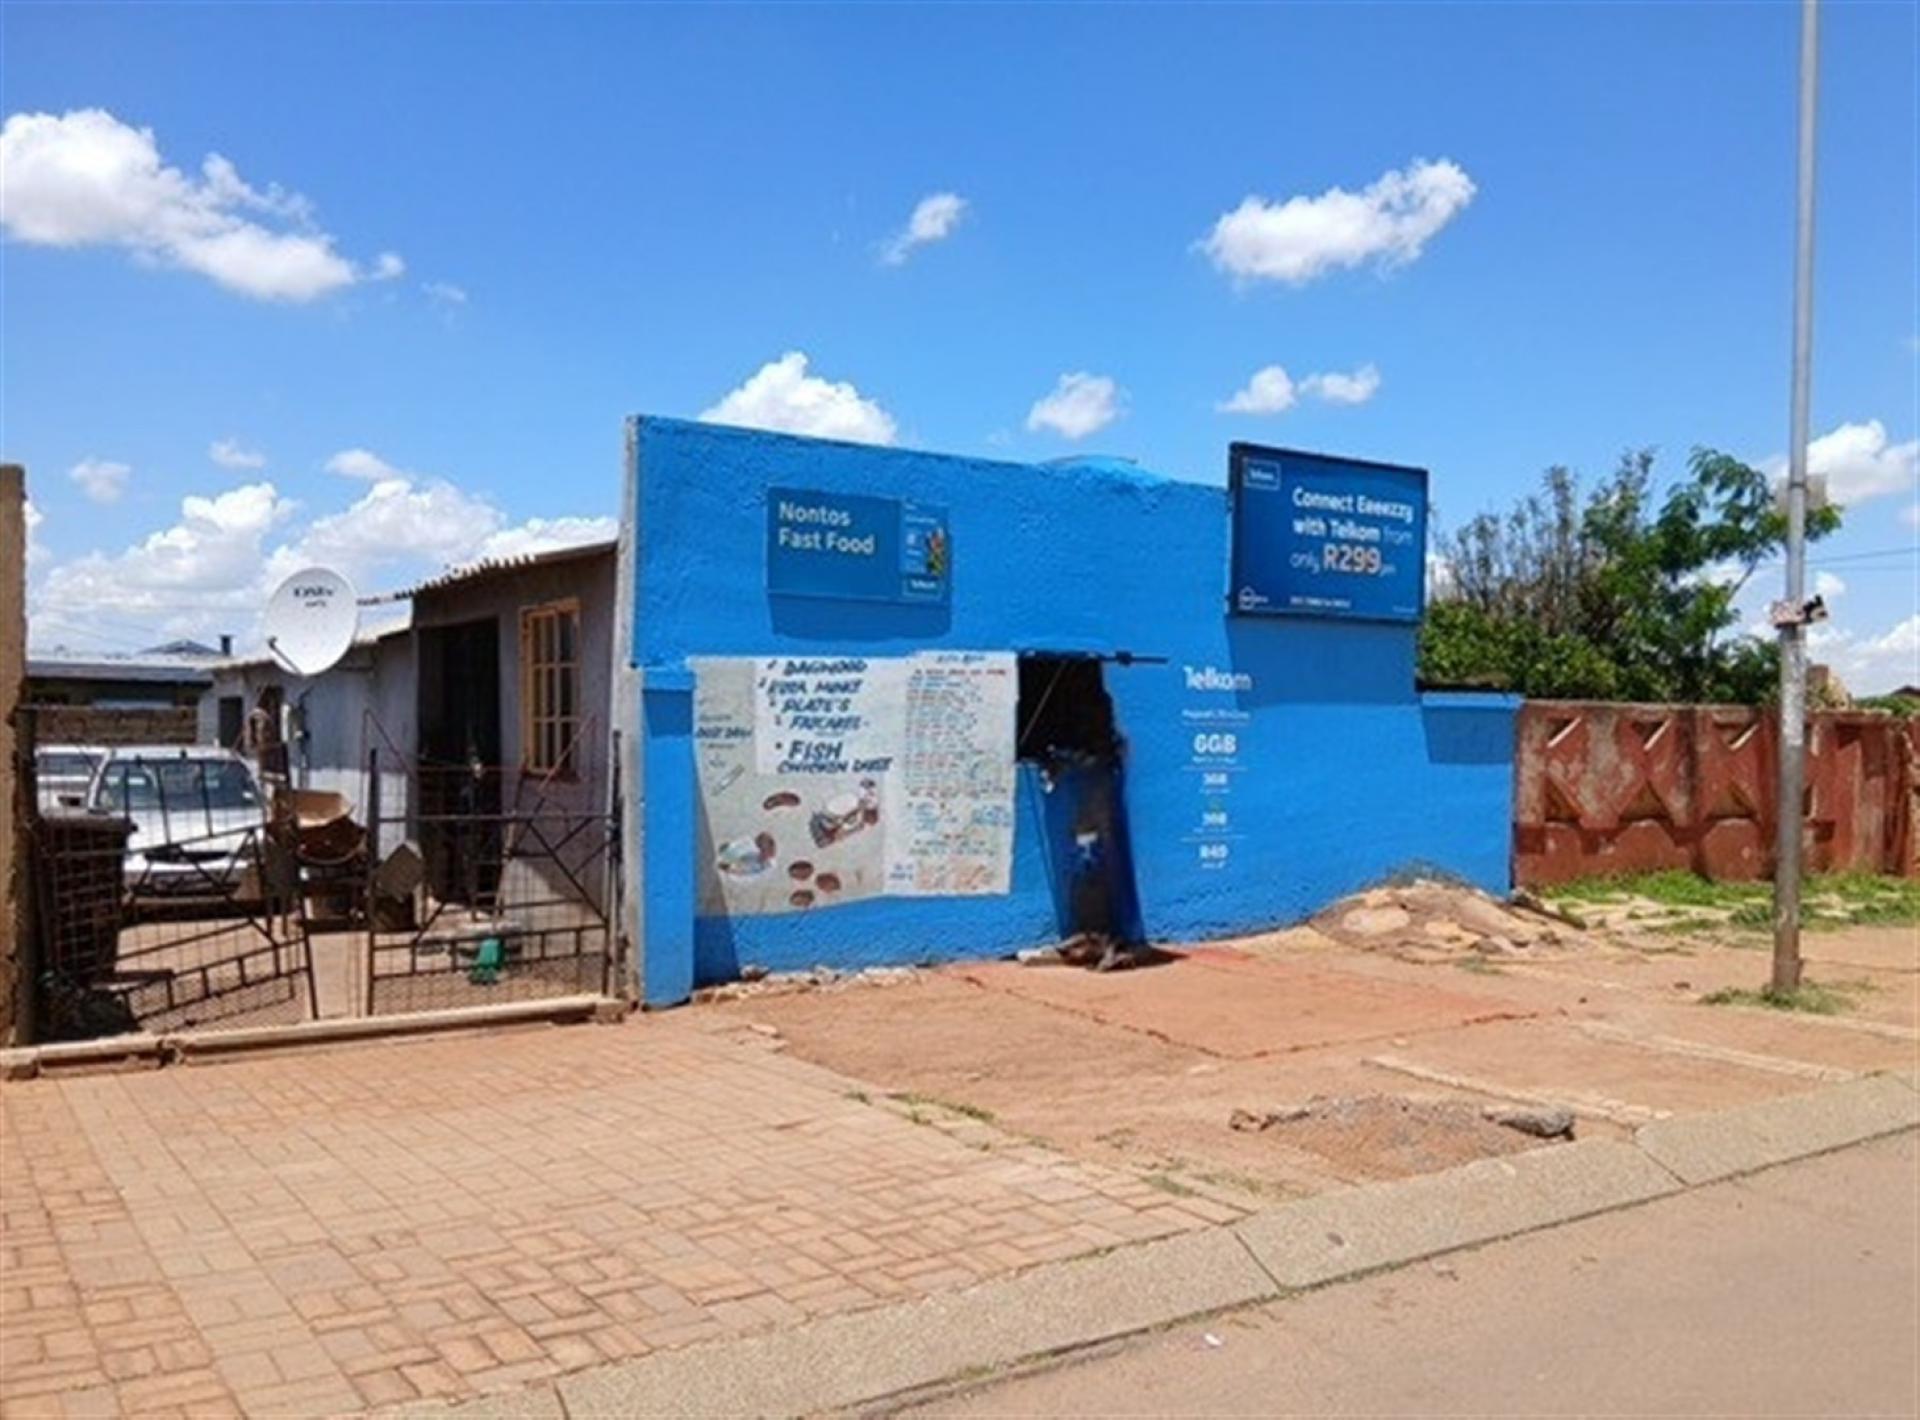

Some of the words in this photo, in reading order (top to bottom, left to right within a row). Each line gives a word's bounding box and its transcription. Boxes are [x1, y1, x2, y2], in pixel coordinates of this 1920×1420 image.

[1292, 487, 1353, 513] Connect
[779, 501, 851, 527] Nontos
[779, 528, 821, 551] Fast
[825, 532, 875, 555] Food
[1292, 516, 1326, 537] with
[1330, 518, 1381, 542] Telkom
[1383, 524, 1412, 545] from
[1289, 550, 1320, 574] only
[1322, 543, 1382, 575] R299
[1183, 665, 1253, 691] Telkom
[788, 739, 844, 760] FISH
[1193, 733, 1237, 755] 6GB
